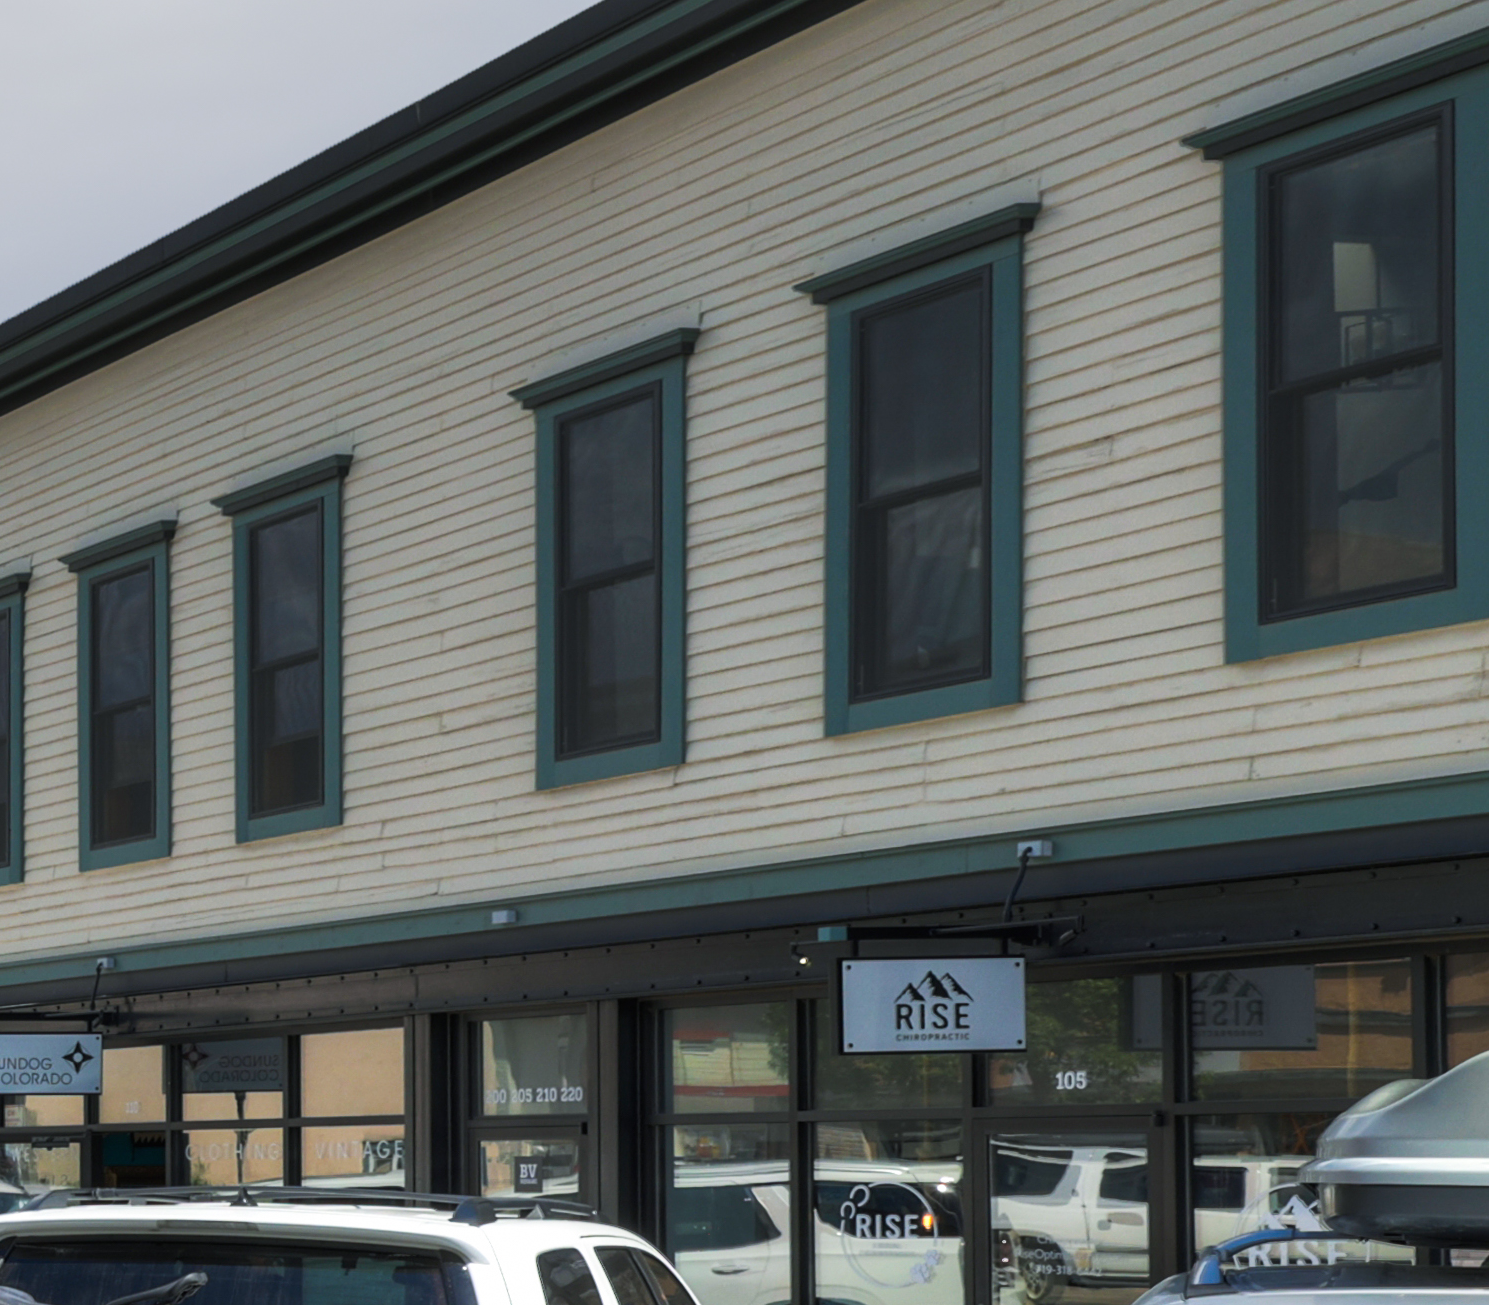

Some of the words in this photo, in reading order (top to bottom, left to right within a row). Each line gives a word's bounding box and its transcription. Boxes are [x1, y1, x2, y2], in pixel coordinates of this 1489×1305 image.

[896, 1003, 970, 1030] RISE
[896, 1033, 970, 1042] CHIROPRACTIC
[1055, 1070, 1087, 1090] 105
[536, 1087, 557, 1102] 210
[561, 1086, 583, 1102] 220
[315, 1139, 404, 1160] VINTAGE
[519, 1164, 537, 1178] BV
[856, 1213, 919, 1239] RISE
